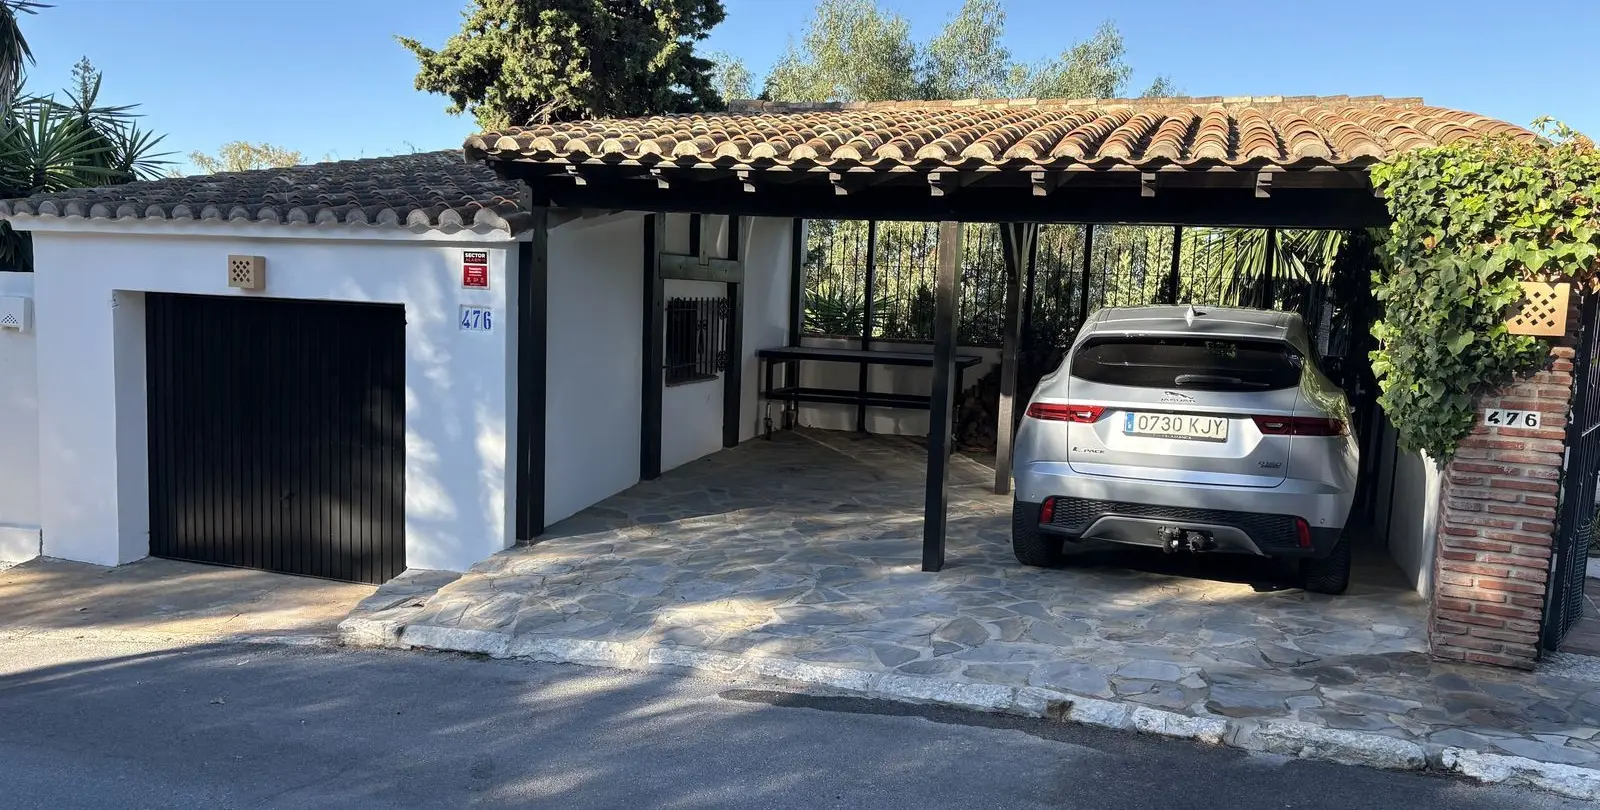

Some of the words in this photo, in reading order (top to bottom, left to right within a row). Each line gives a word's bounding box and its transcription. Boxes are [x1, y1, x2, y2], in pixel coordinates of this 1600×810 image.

[461, 310, 491, 330] 476
[1138, 415, 1183, 432] 0730
[1189, 417, 1223, 435] KJY
[1487, 411, 1537, 427] 476
